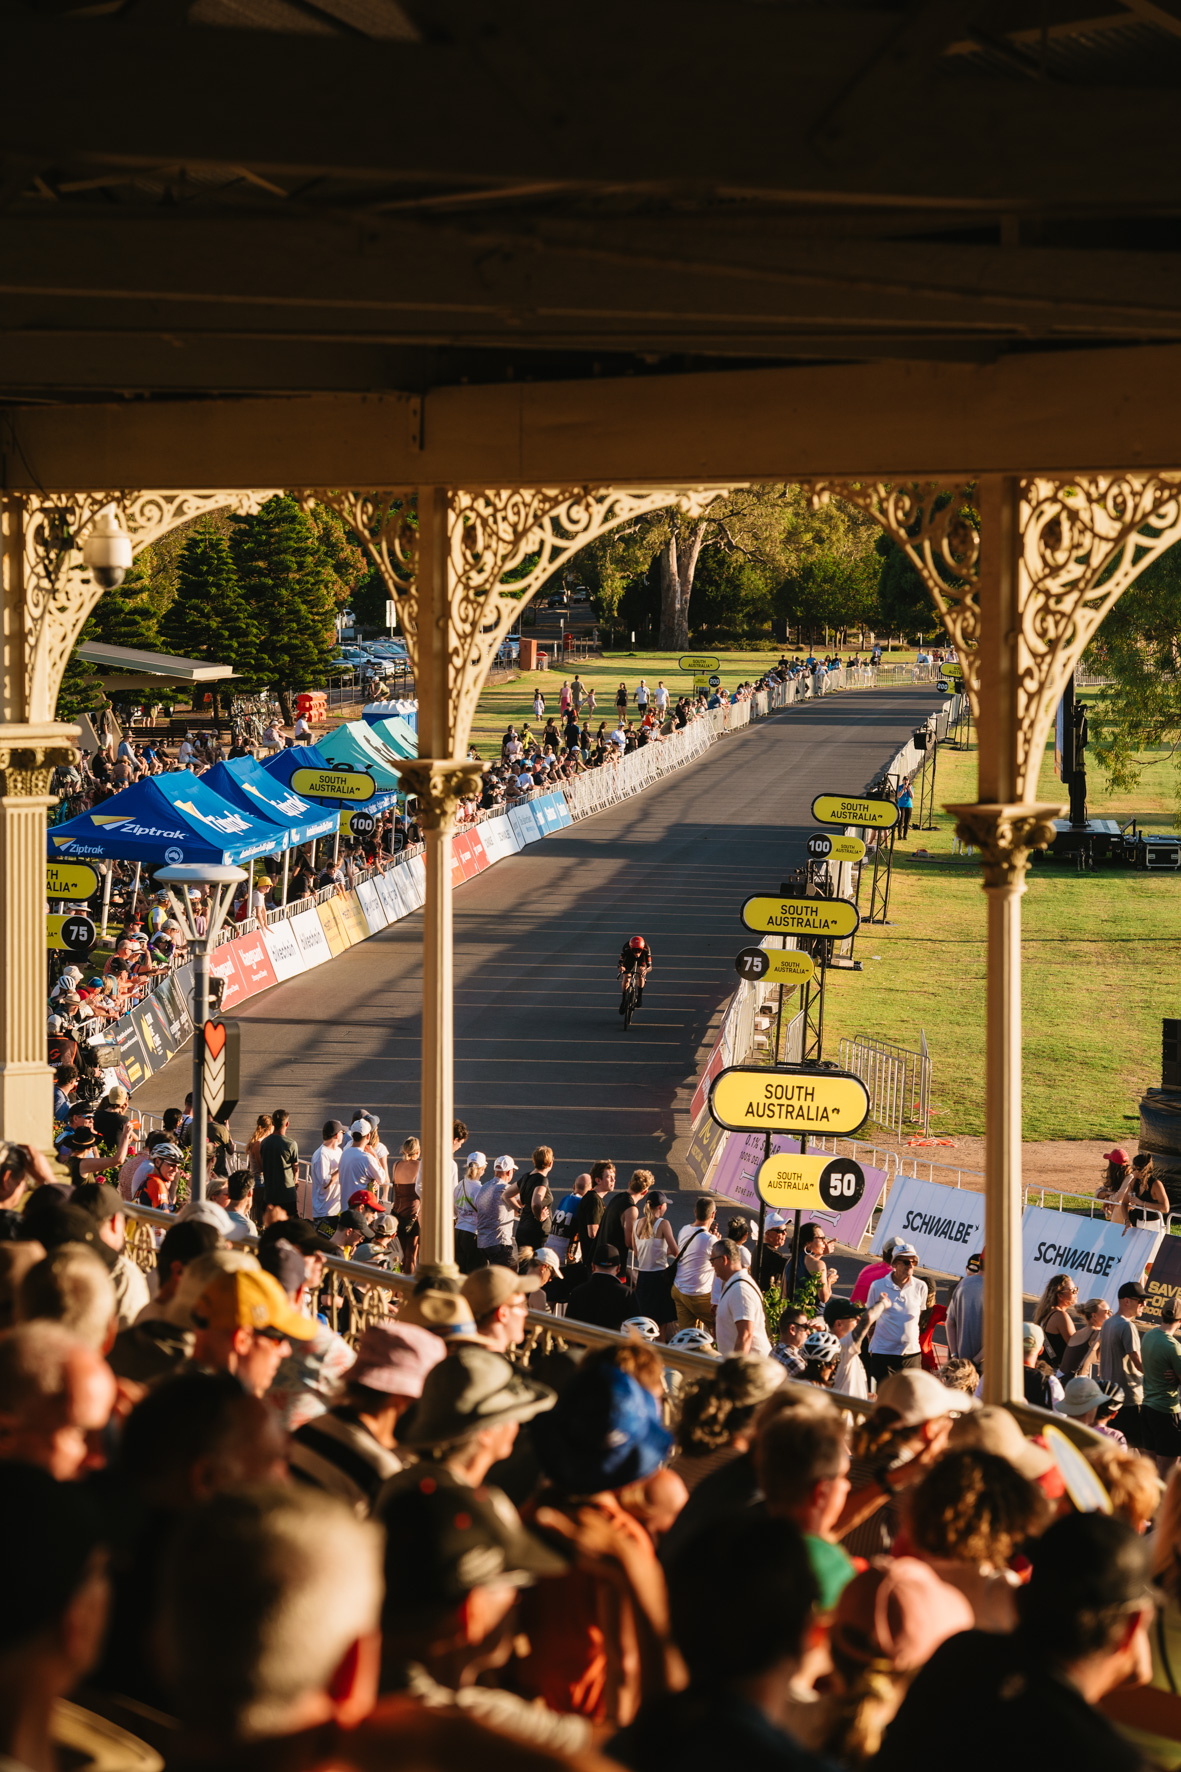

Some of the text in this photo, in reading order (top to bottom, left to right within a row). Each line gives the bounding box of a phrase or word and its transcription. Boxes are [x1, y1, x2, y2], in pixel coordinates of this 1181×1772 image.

[319, 775, 347, 785] SOUTH
[309, 783, 355, 794] AUSTRALIA
[841, 802, 869, 812] SOUTH
[830, 810, 878, 822] AUSTRALIA
[351, 818, 373, 830] 100
[120, 823, 186, 840] Ziptrak
[69, 843, 104, 855] Ziptrak
[808, 840, 830, 852] 100
[780, 904, 819, 917] SOUTH
[766, 915, 831, 930] AUSTRALIA
[69, 925, 88, 941] 75
[743, 956, 763, 972] 75
[774, 966, 806, 974] AUSTRALIA
[780, 961, 800, 969] SOUTH
[764, 1083, 815, 1102] SOUTH
[744, 1101, 830, 1122] AUSTRALIA
[776, 1171, 803, 1181] SOUTH
[767, 1180, 810, 1191] AUSTRALIA
[829, 1173, 856, 1197] 50
[902, 1210, 974, 1244] SCHWALBE
[1033, 1241, 1115, 1277] SCHWALBE
